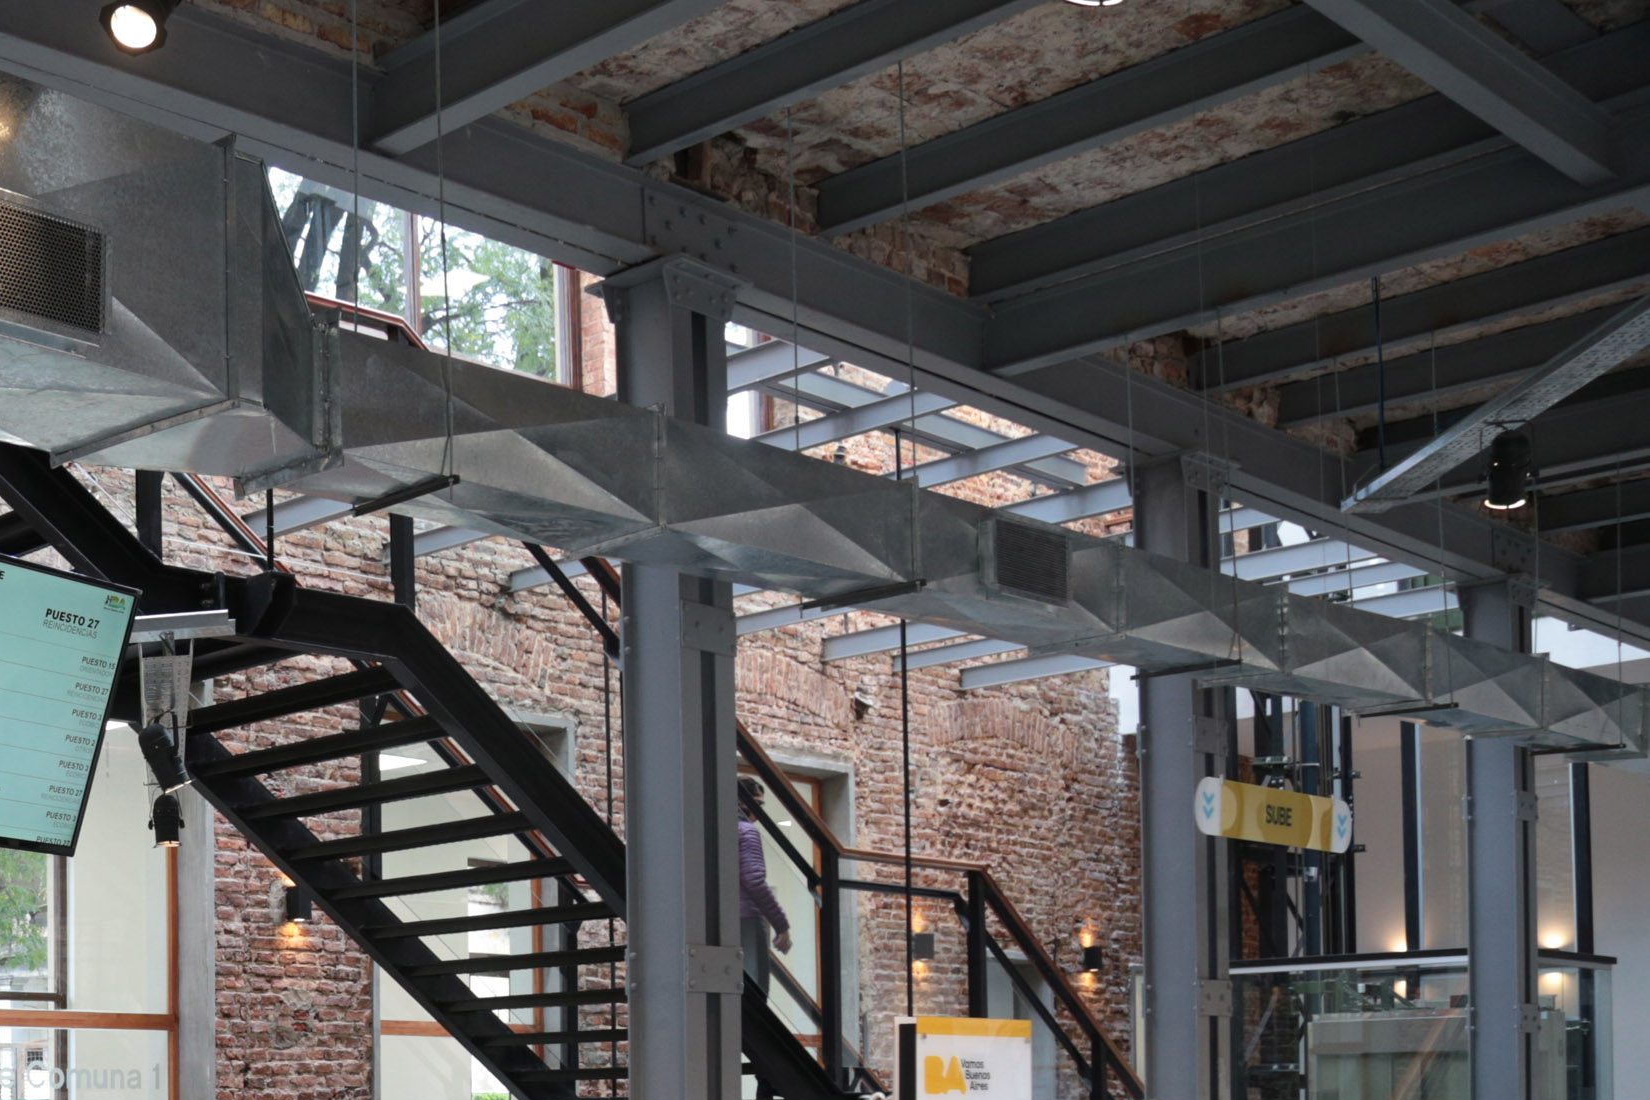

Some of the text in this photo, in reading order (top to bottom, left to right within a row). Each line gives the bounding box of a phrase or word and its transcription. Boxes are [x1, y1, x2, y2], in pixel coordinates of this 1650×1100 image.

[46, 608, 100, 629] PUESTO 27
[43, 619, 97, 638] REINCIDENCIAS
[82, 656, 107, 667] PUESTO
[75, 682, 109, 695] PUESTO 27
[71, 709, 97, 720] PUESTO
[65, 734, 90, 745] PUESTO
[58, 760, 84, 770] PUESTO
[48, 785, 74, 795] PUESTO
[46, 811, 71, 821] PUESTO
[1265, 804, 1293, 827] SUBE
[36, 836, 62, 844] PUESTO
[961, 1058, 984, 1070] Vamos
[26, 1060, 142, 1090] Comuna
[924, 1055, 967, 1095] BA
[965, 1069, 991, 1081] Buenos
[969, 1080, 989, 1091] Aires
